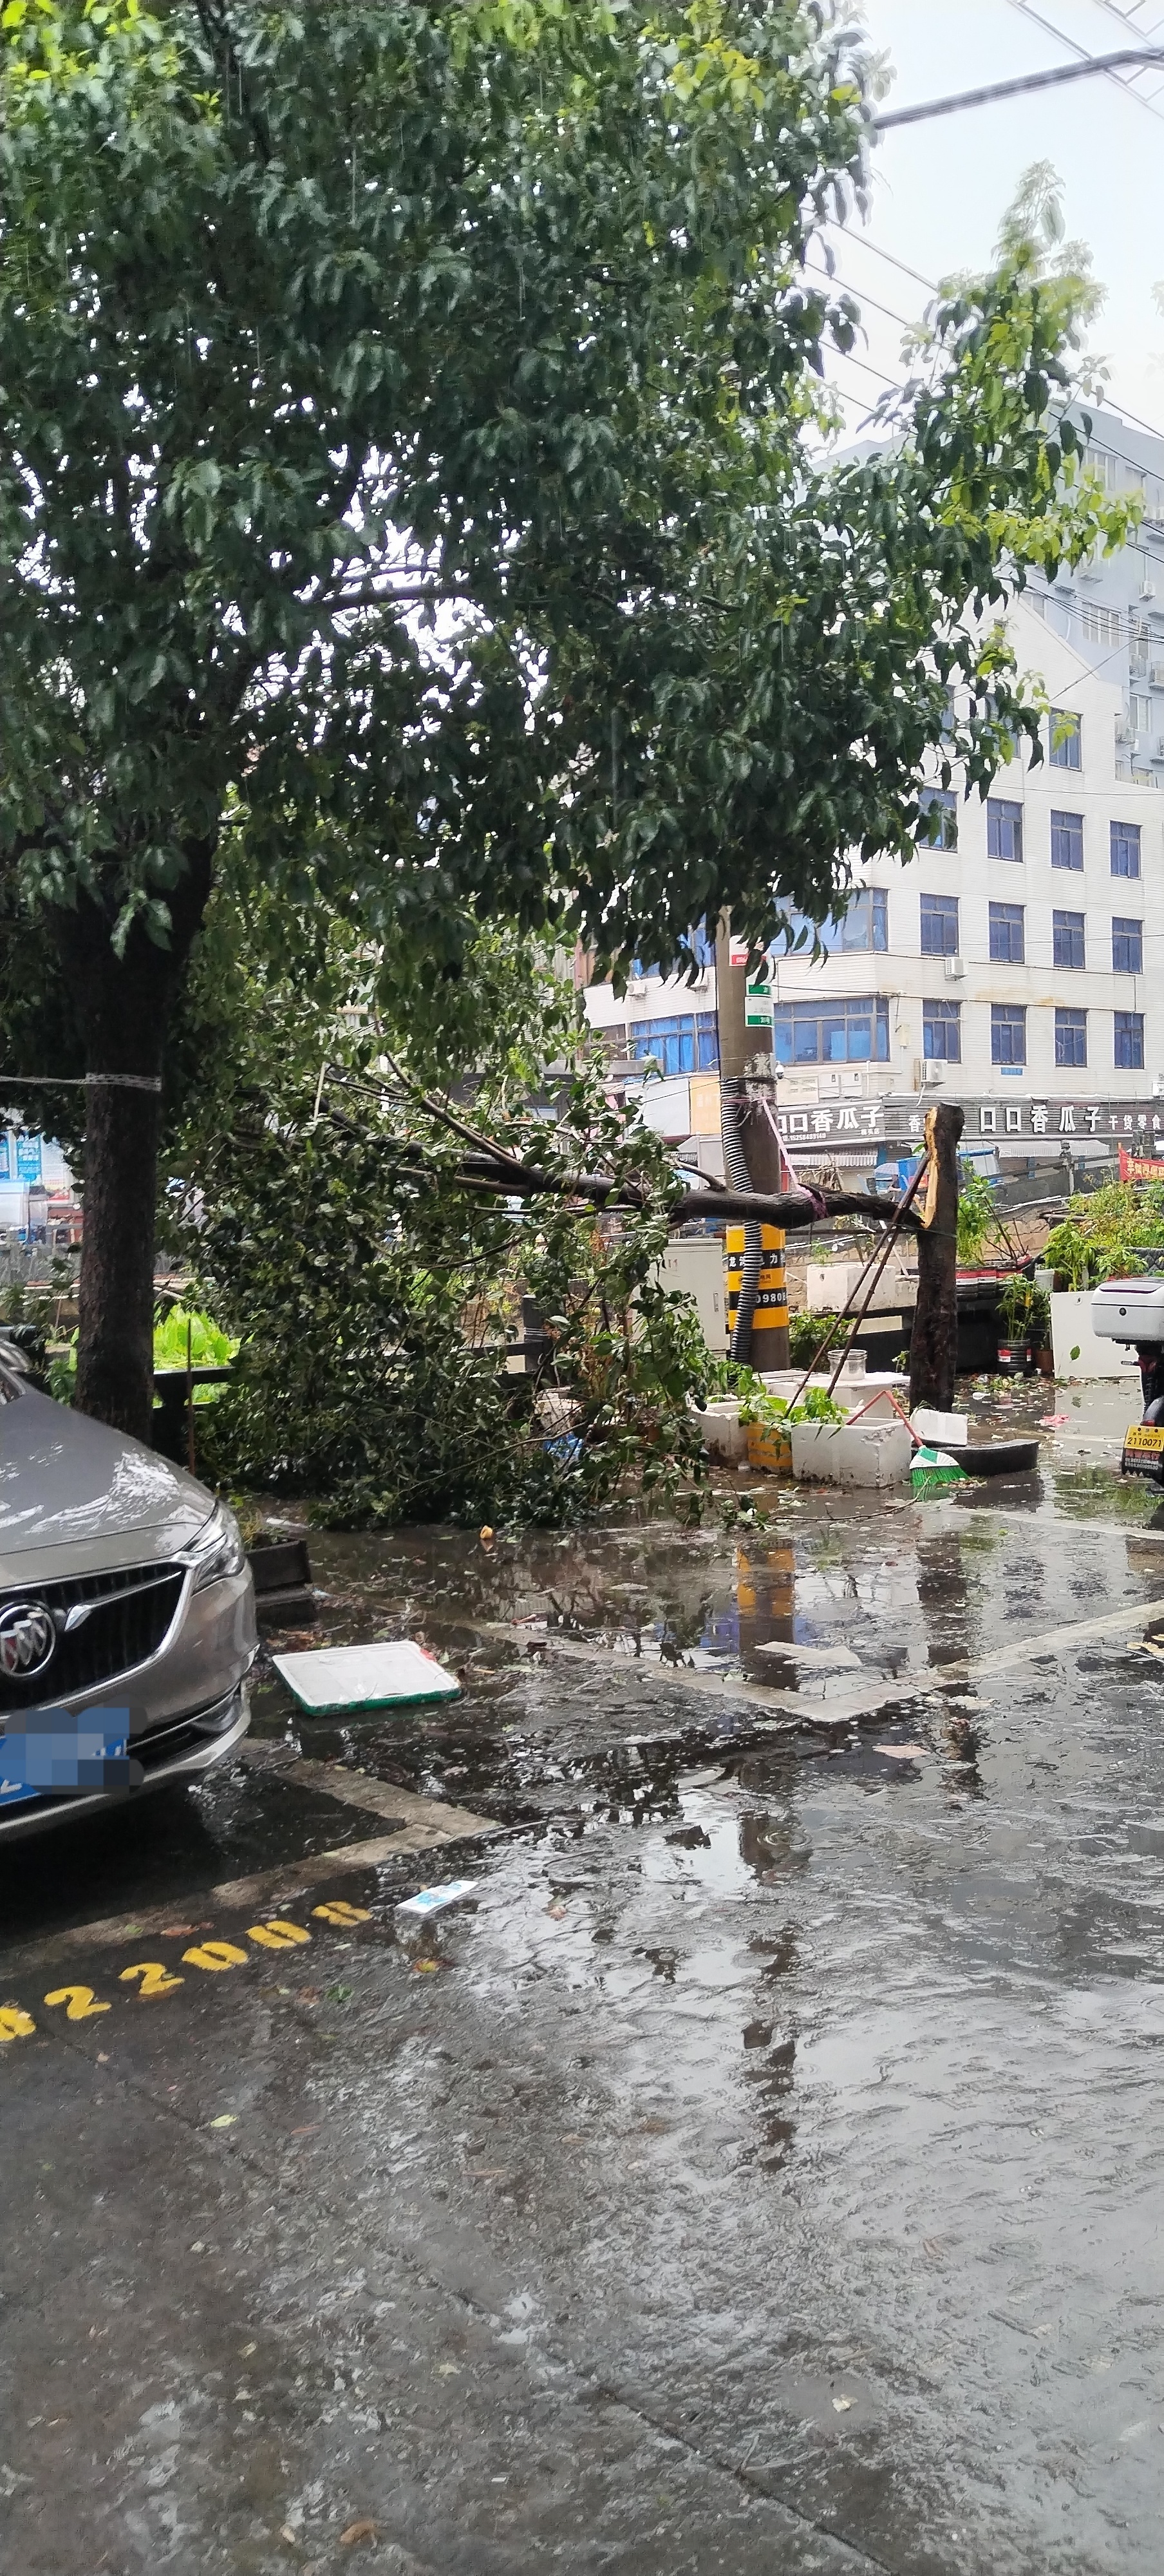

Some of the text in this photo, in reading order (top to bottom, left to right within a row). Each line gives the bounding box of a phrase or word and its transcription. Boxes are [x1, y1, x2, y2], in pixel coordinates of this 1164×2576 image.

[980, 1104, 1102, 1133] 口口香瓜子
[1108, 1115, 1161, 1131] 干货零食
[1127, 1437, 1161, 1448] 2110071
